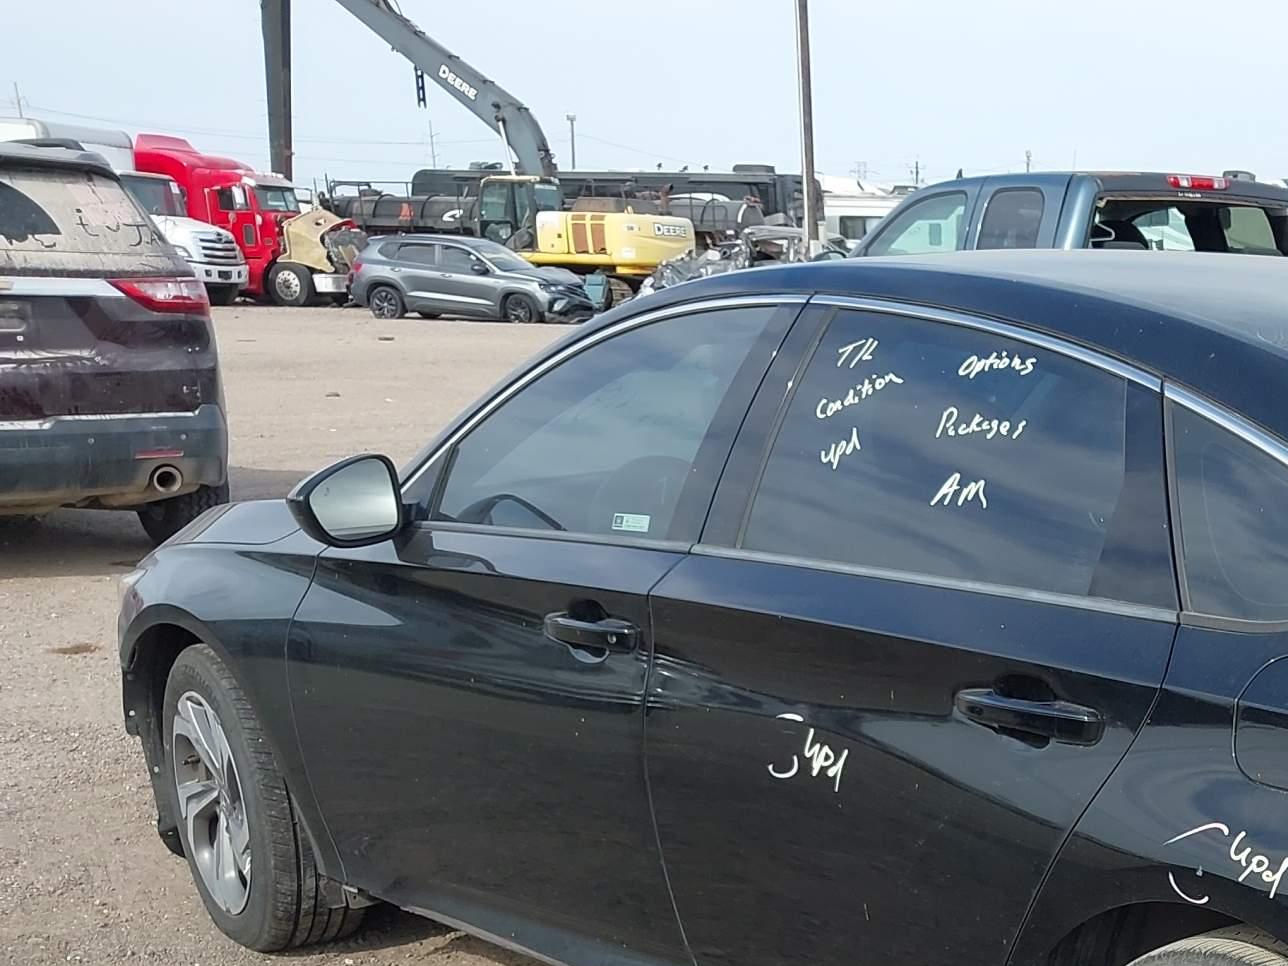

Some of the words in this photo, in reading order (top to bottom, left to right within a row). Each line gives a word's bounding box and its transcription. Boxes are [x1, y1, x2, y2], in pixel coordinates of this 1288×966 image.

[438, 63, 478, 101] DEERE
[654, 223, 687, 237] DEERE
[958, 351, 1037, 379] Options
[816, 373, 904, 419] Condition
